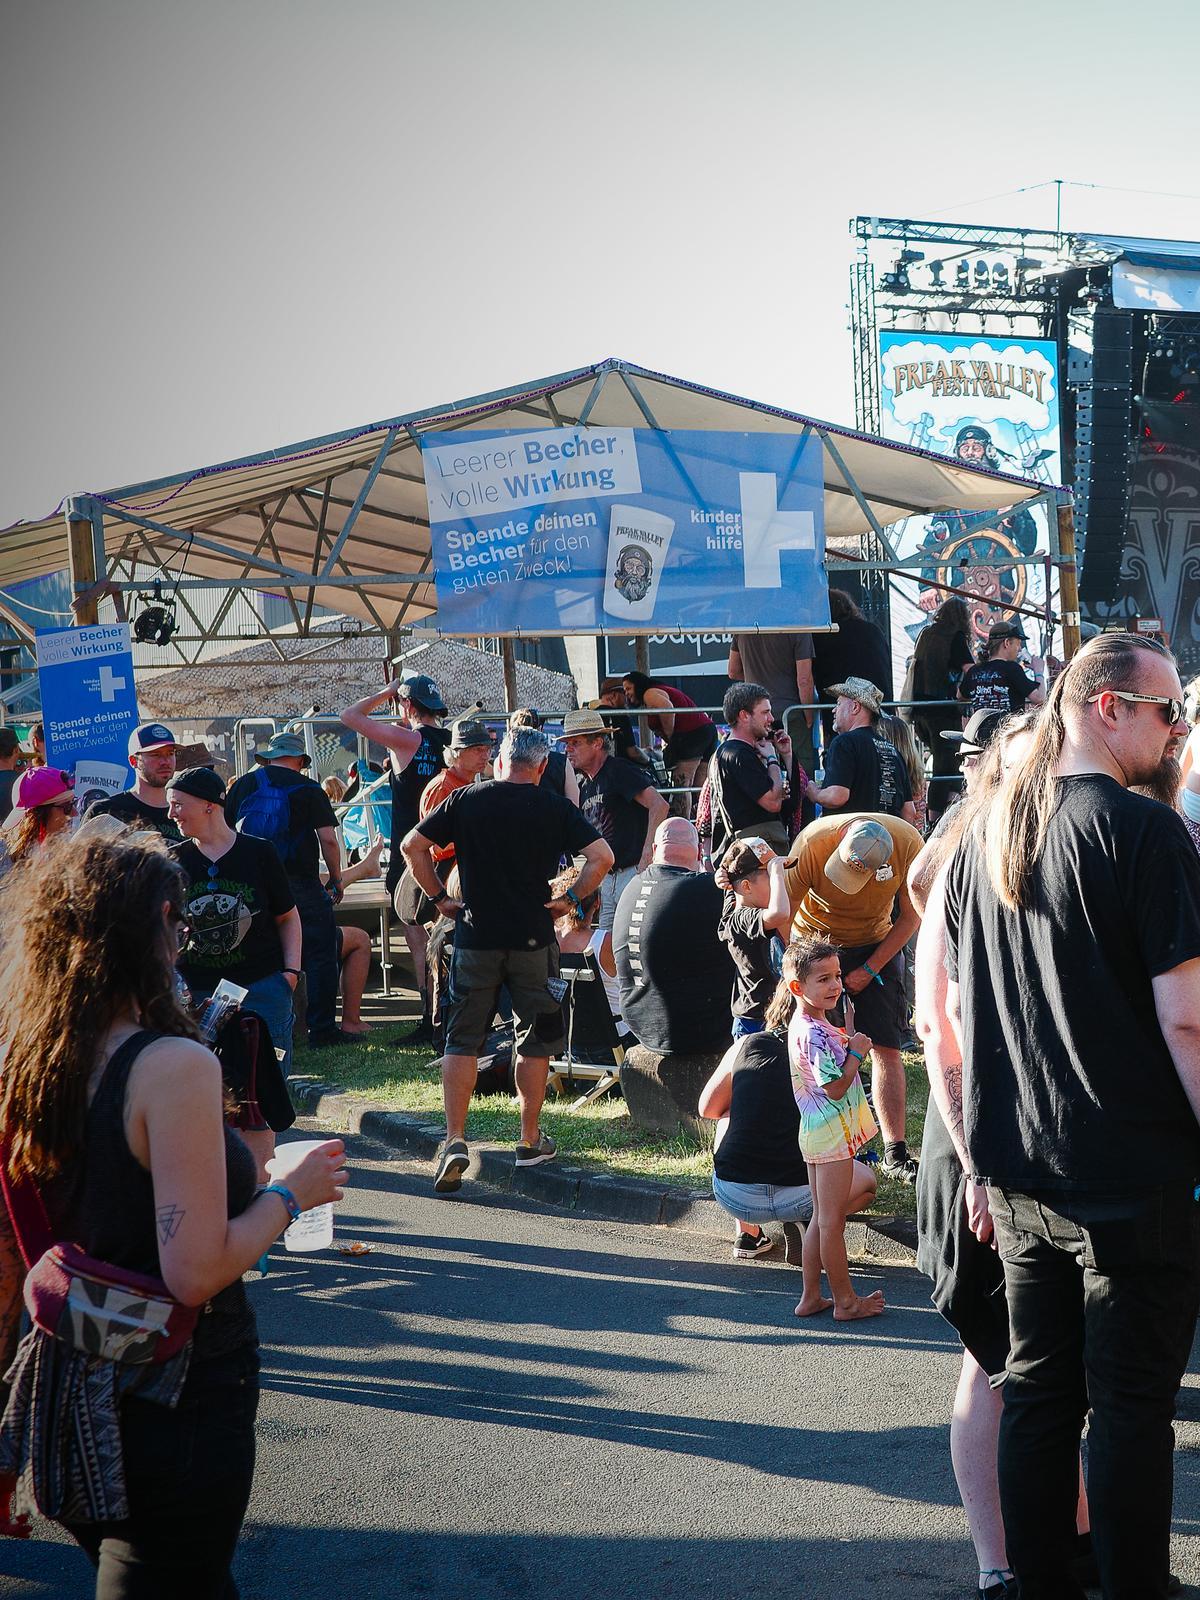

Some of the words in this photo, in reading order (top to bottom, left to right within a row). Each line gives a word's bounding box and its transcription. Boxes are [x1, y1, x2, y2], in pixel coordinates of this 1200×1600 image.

[893, 360, 966, 398] FREAK
[970, 360, 1047, 404] VALLEY
[932, 377, 1011, 400] FESTIVAL
[436, 449, 517, 478] Leerer
[523, 435, 624, 465] Becher,
[440, 482, 499, 510] volle
[503, 468, 616, 499] Wirkung
[690, 509, 741, 523] kinder
[446, 520, 529, 551] Spende
[534, 511, 598, 533] deinen
[640, 530, 664, 547] VALLEY
[715, 524, 742, 535] not
[448, 543, 526, 571] Becher
[529, 538, 550, 556] für
[554, 534, 590, 551] den
[706, 536, 742, 549] hilfe
[452, 568, 510, 594] guten
[513, 555, 573, 581] Zweck!
[40, 636, 76, 649] Leerer
[43, 649, 70, 662] volle
[71, 641, 124, 657] Wirkung
[50, 716, 91, 731] Spende
[94, 711, 131, 723] deinen
[51, 729, 90, 742] Becher
[92, 726, 105, 735] für
[109, 722, 128, 732] den
[52, 741, 81, 755] guten
[83, 733, 119, 748] Zweck!
